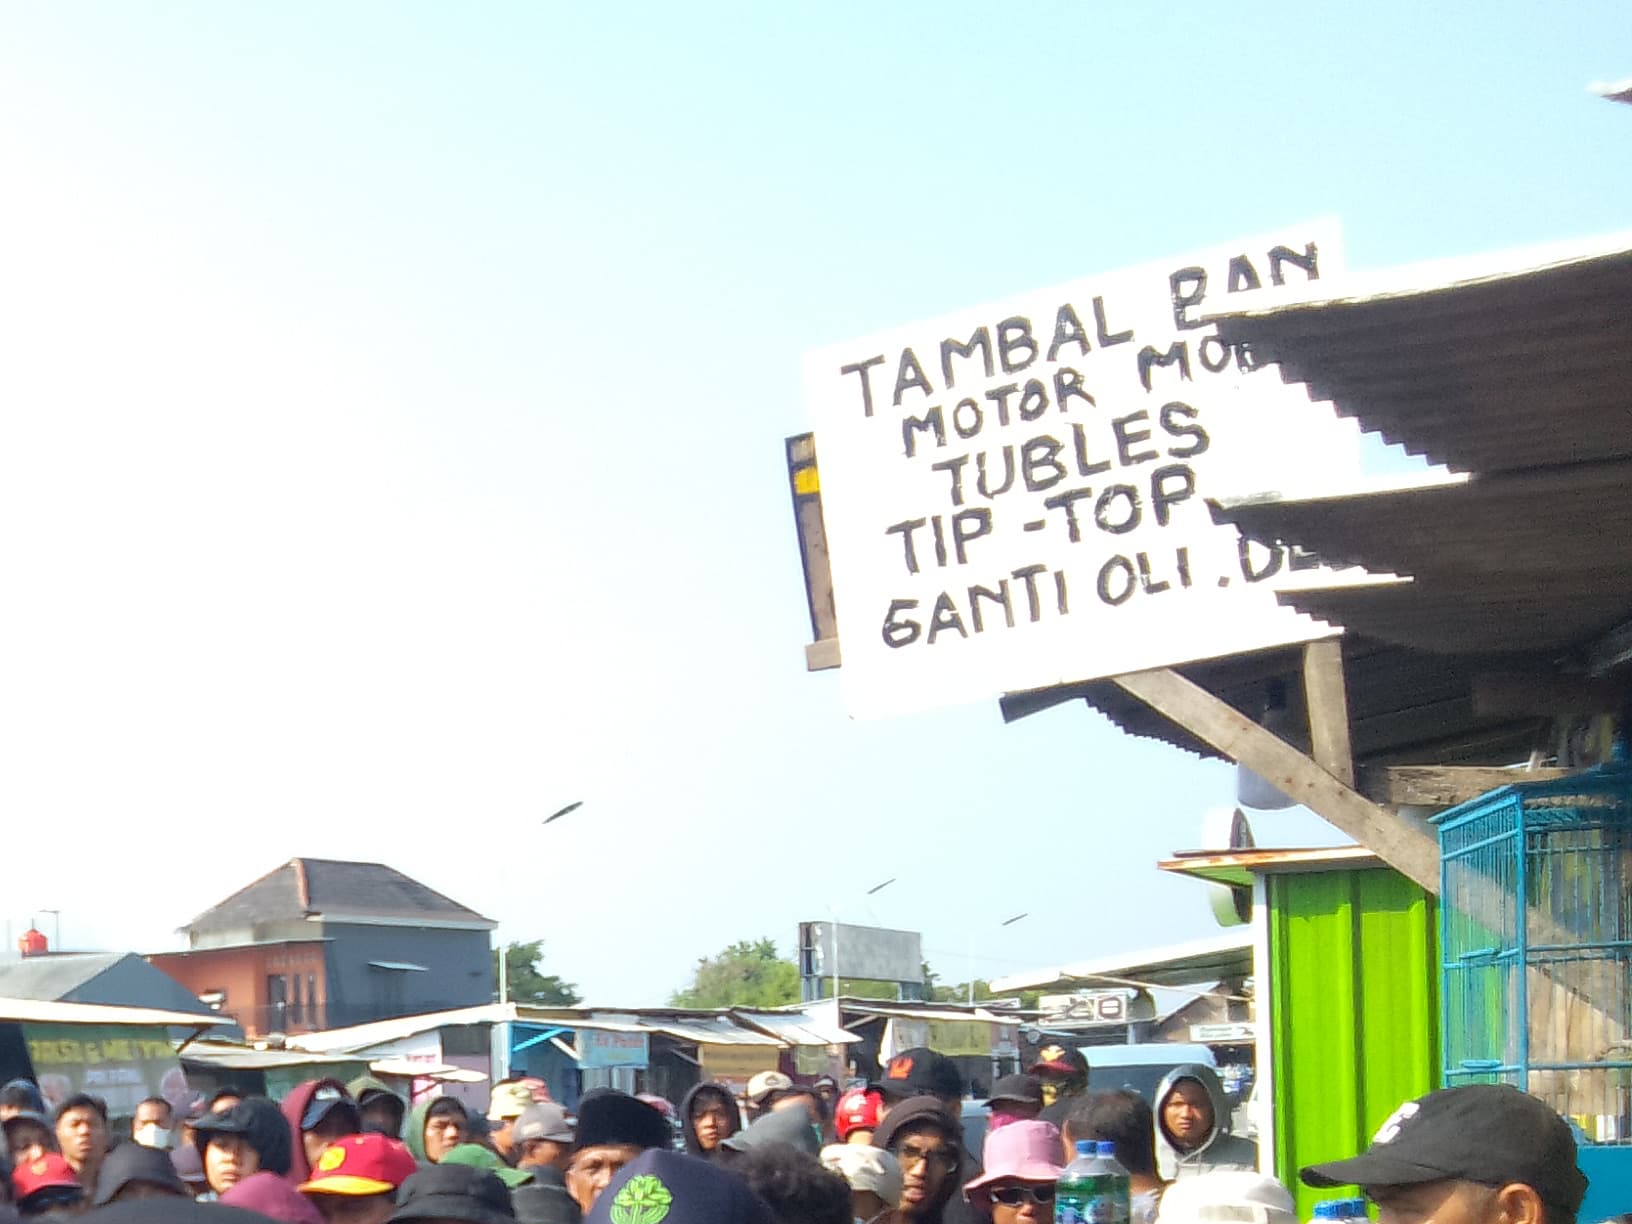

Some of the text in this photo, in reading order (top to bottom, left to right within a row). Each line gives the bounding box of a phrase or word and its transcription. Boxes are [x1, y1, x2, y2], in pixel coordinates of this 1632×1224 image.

[842, 296, 1134, 418] TAMBAL
[902, 366, 1096, 458] MOTOR
[931, 401, 1211, 505] TUBLES
[881, 564, 1069, 649] GANTI
